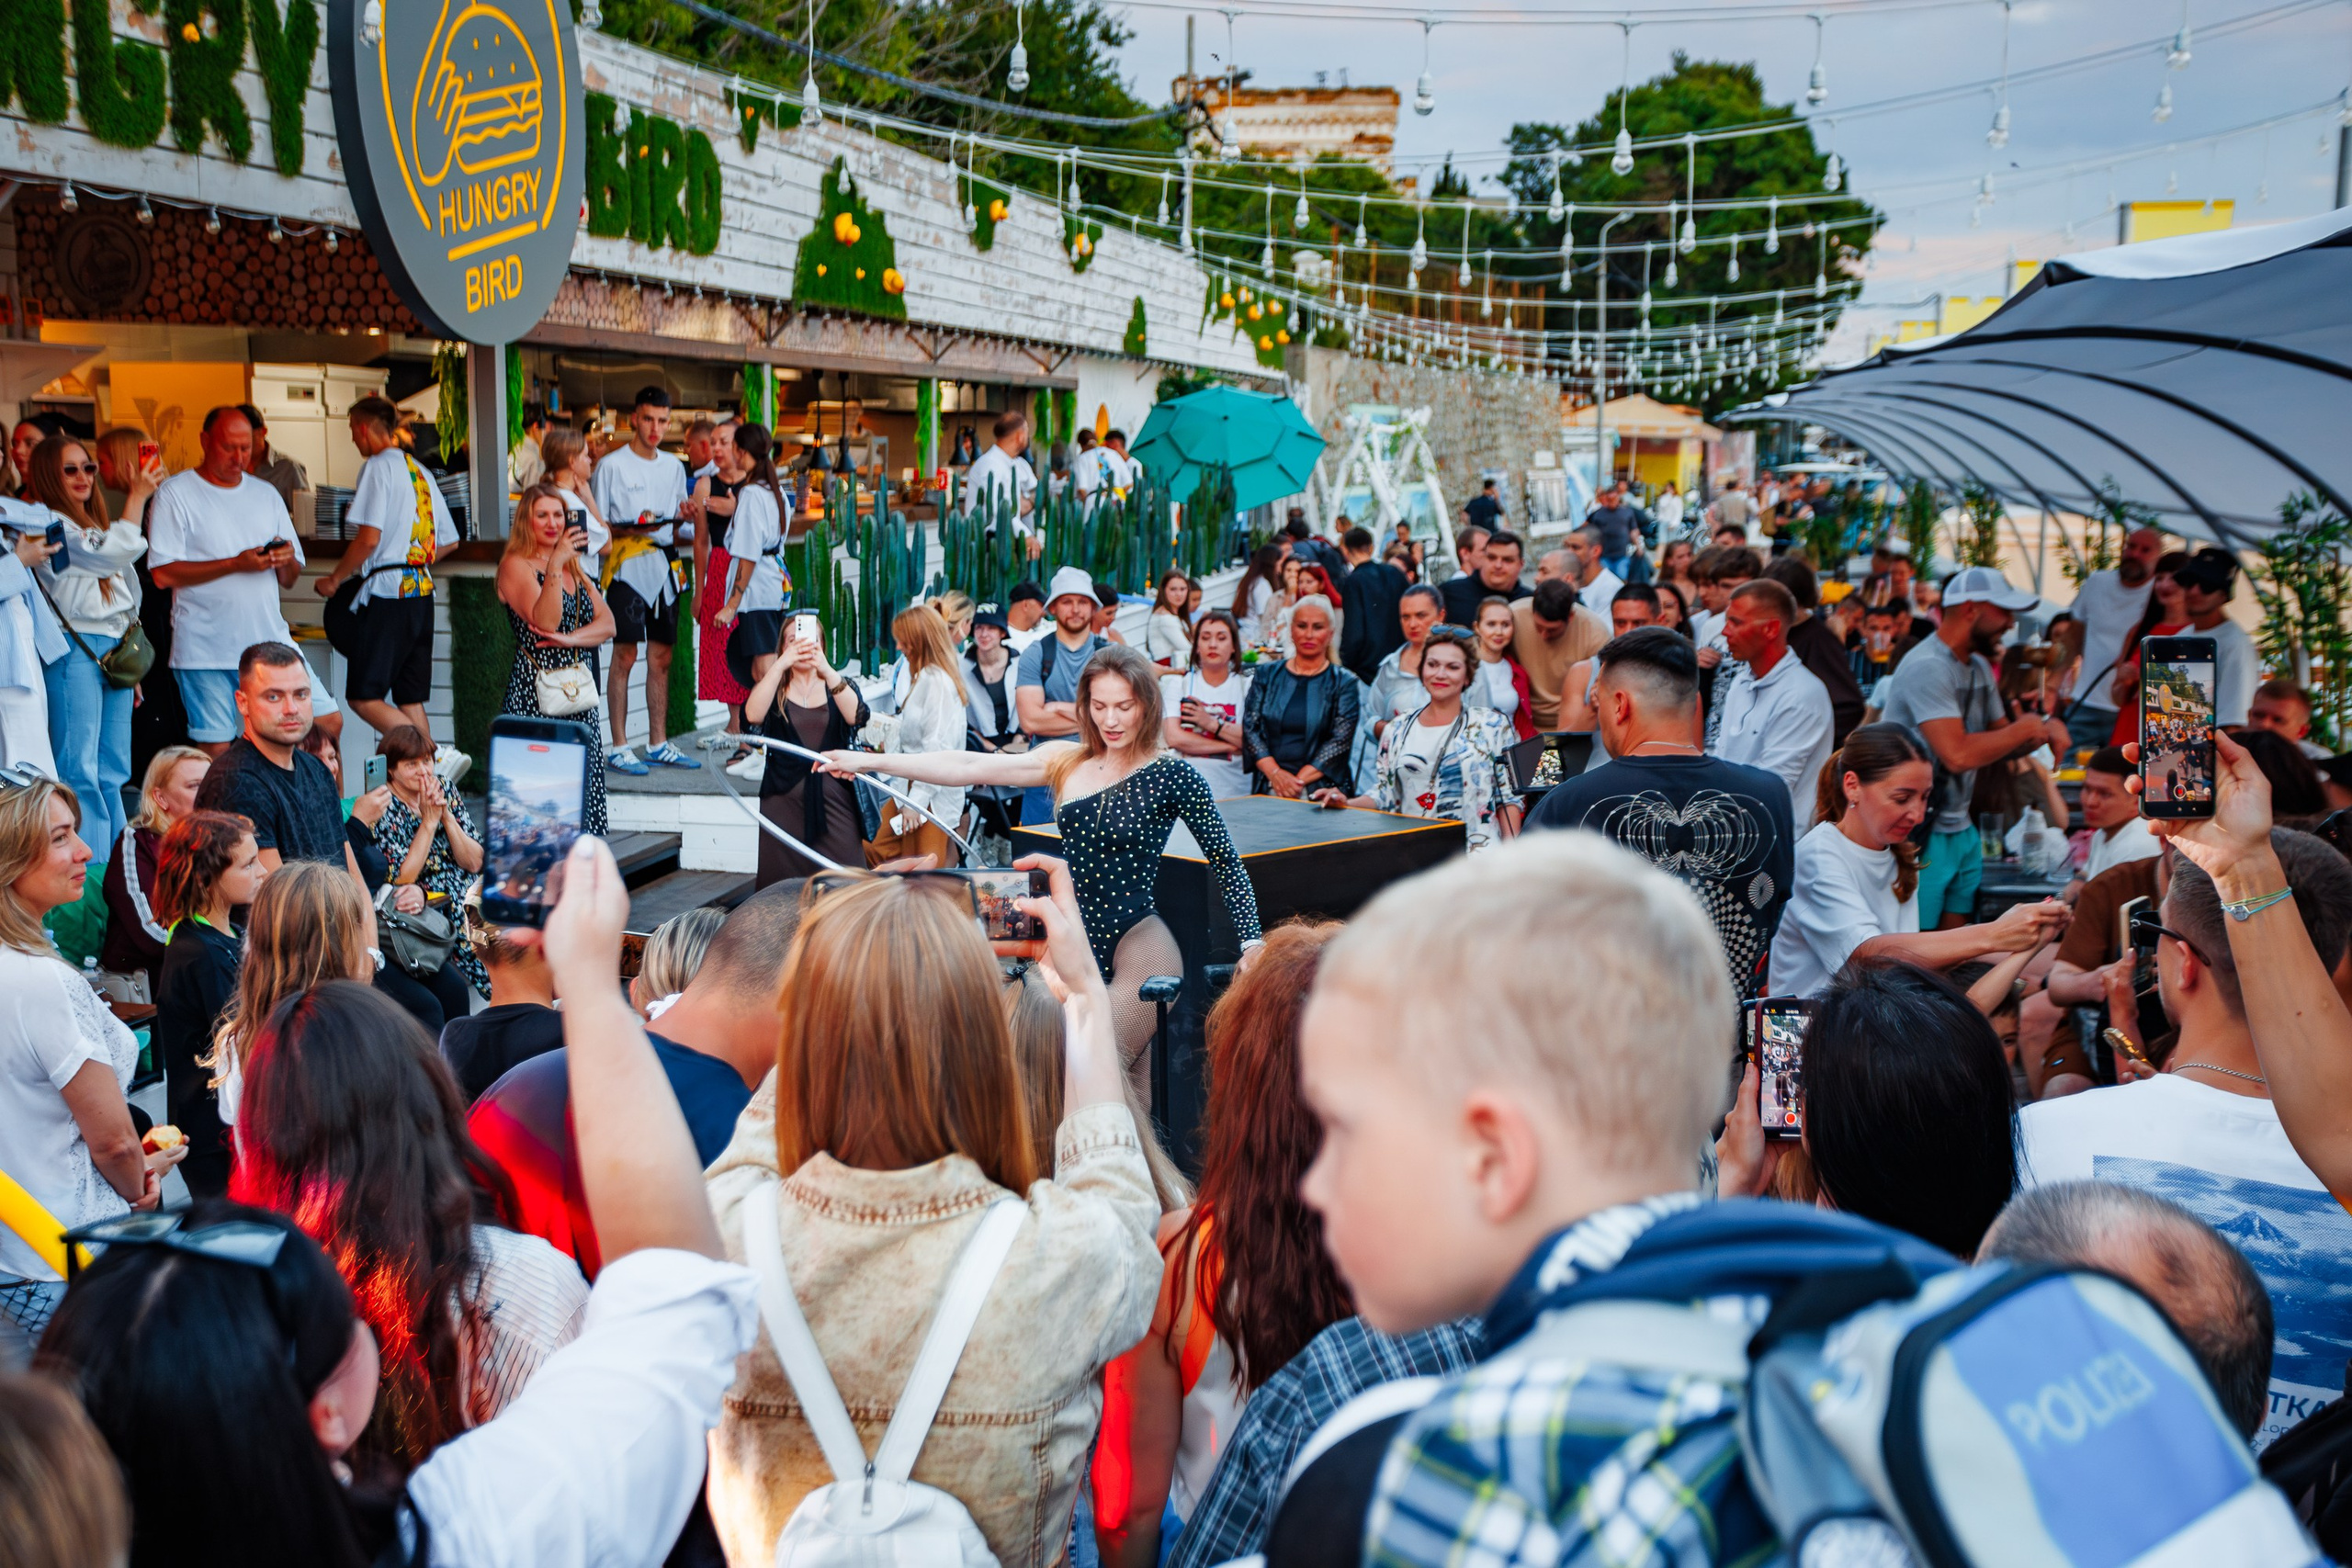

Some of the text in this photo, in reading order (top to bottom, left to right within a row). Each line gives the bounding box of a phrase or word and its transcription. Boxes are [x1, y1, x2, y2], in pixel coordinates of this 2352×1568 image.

[438, 166, 543, 238] HUNGRY
[585, 91, 722, 256] BIRD
[465, 254, 523, 313] BIRD
